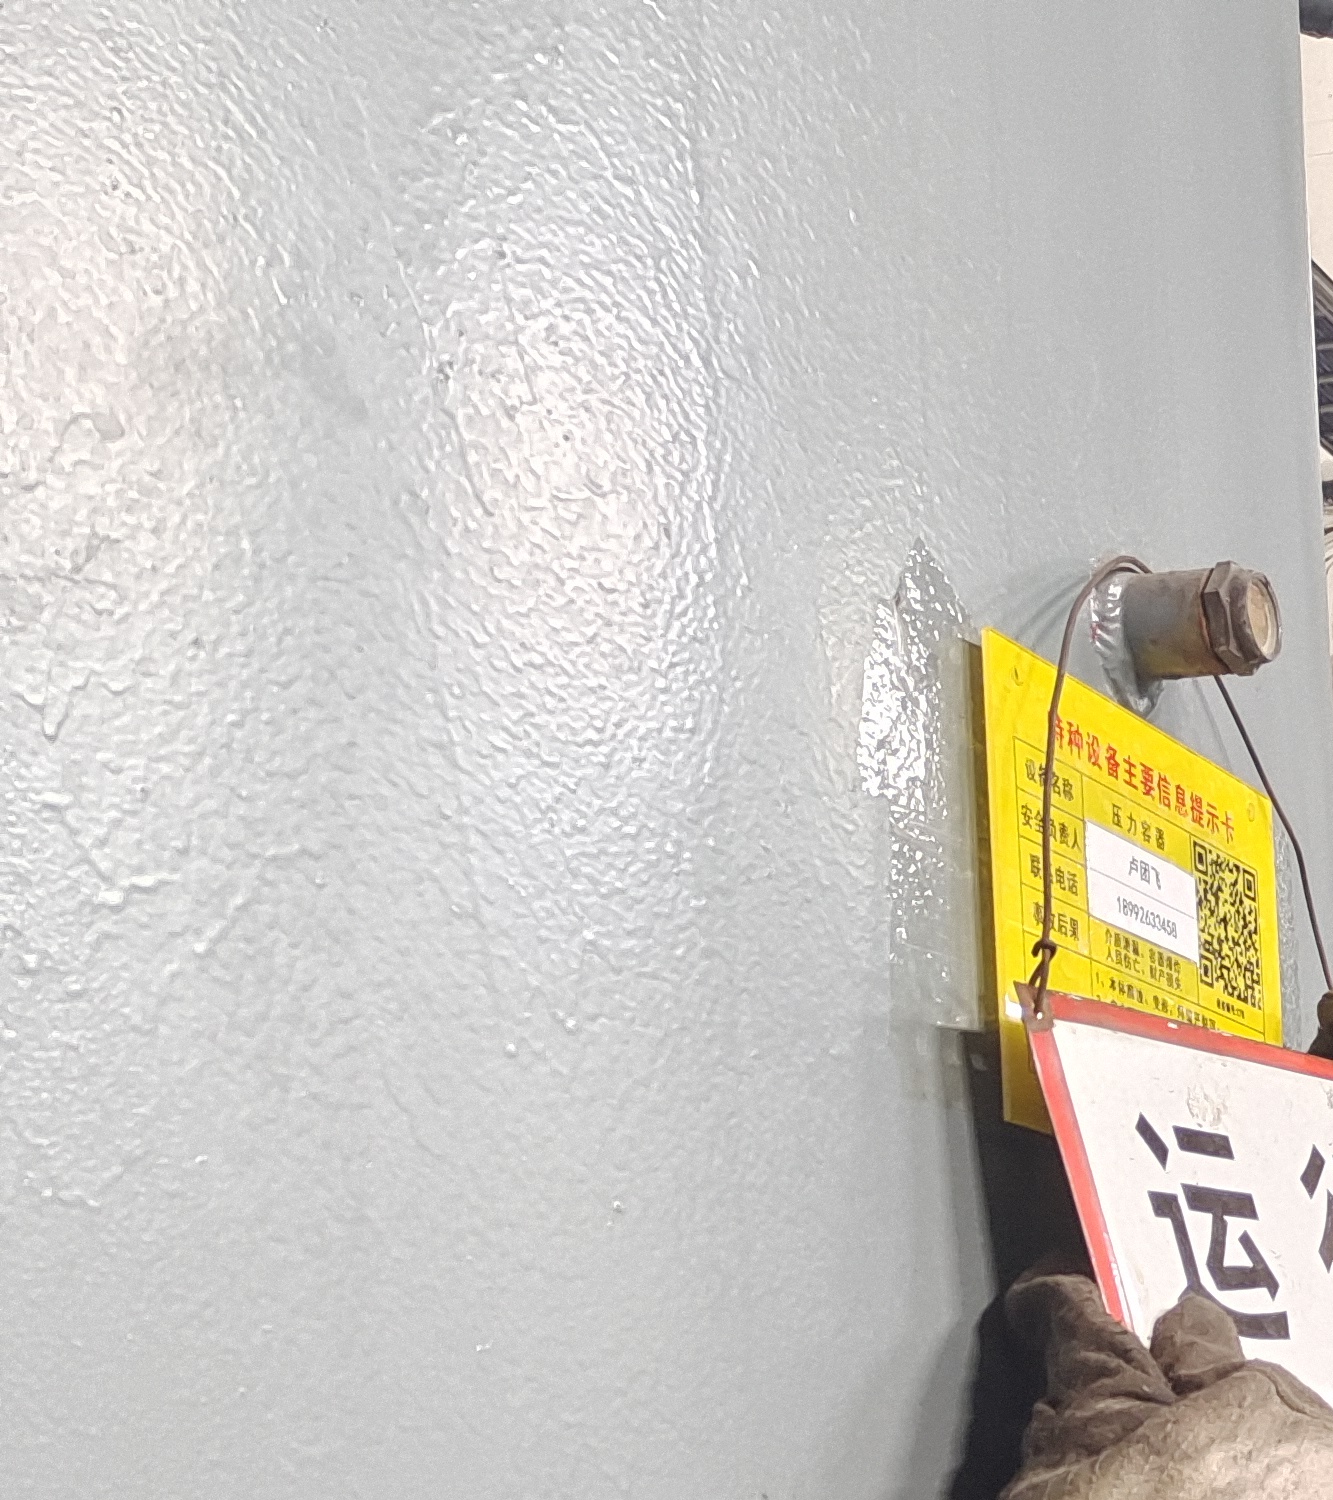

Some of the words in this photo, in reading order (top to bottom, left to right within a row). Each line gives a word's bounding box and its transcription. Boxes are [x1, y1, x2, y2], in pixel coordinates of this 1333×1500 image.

[1112, 803, 1165, 851] 压力容器
[1029, 853, 1079, 896] 联电话
